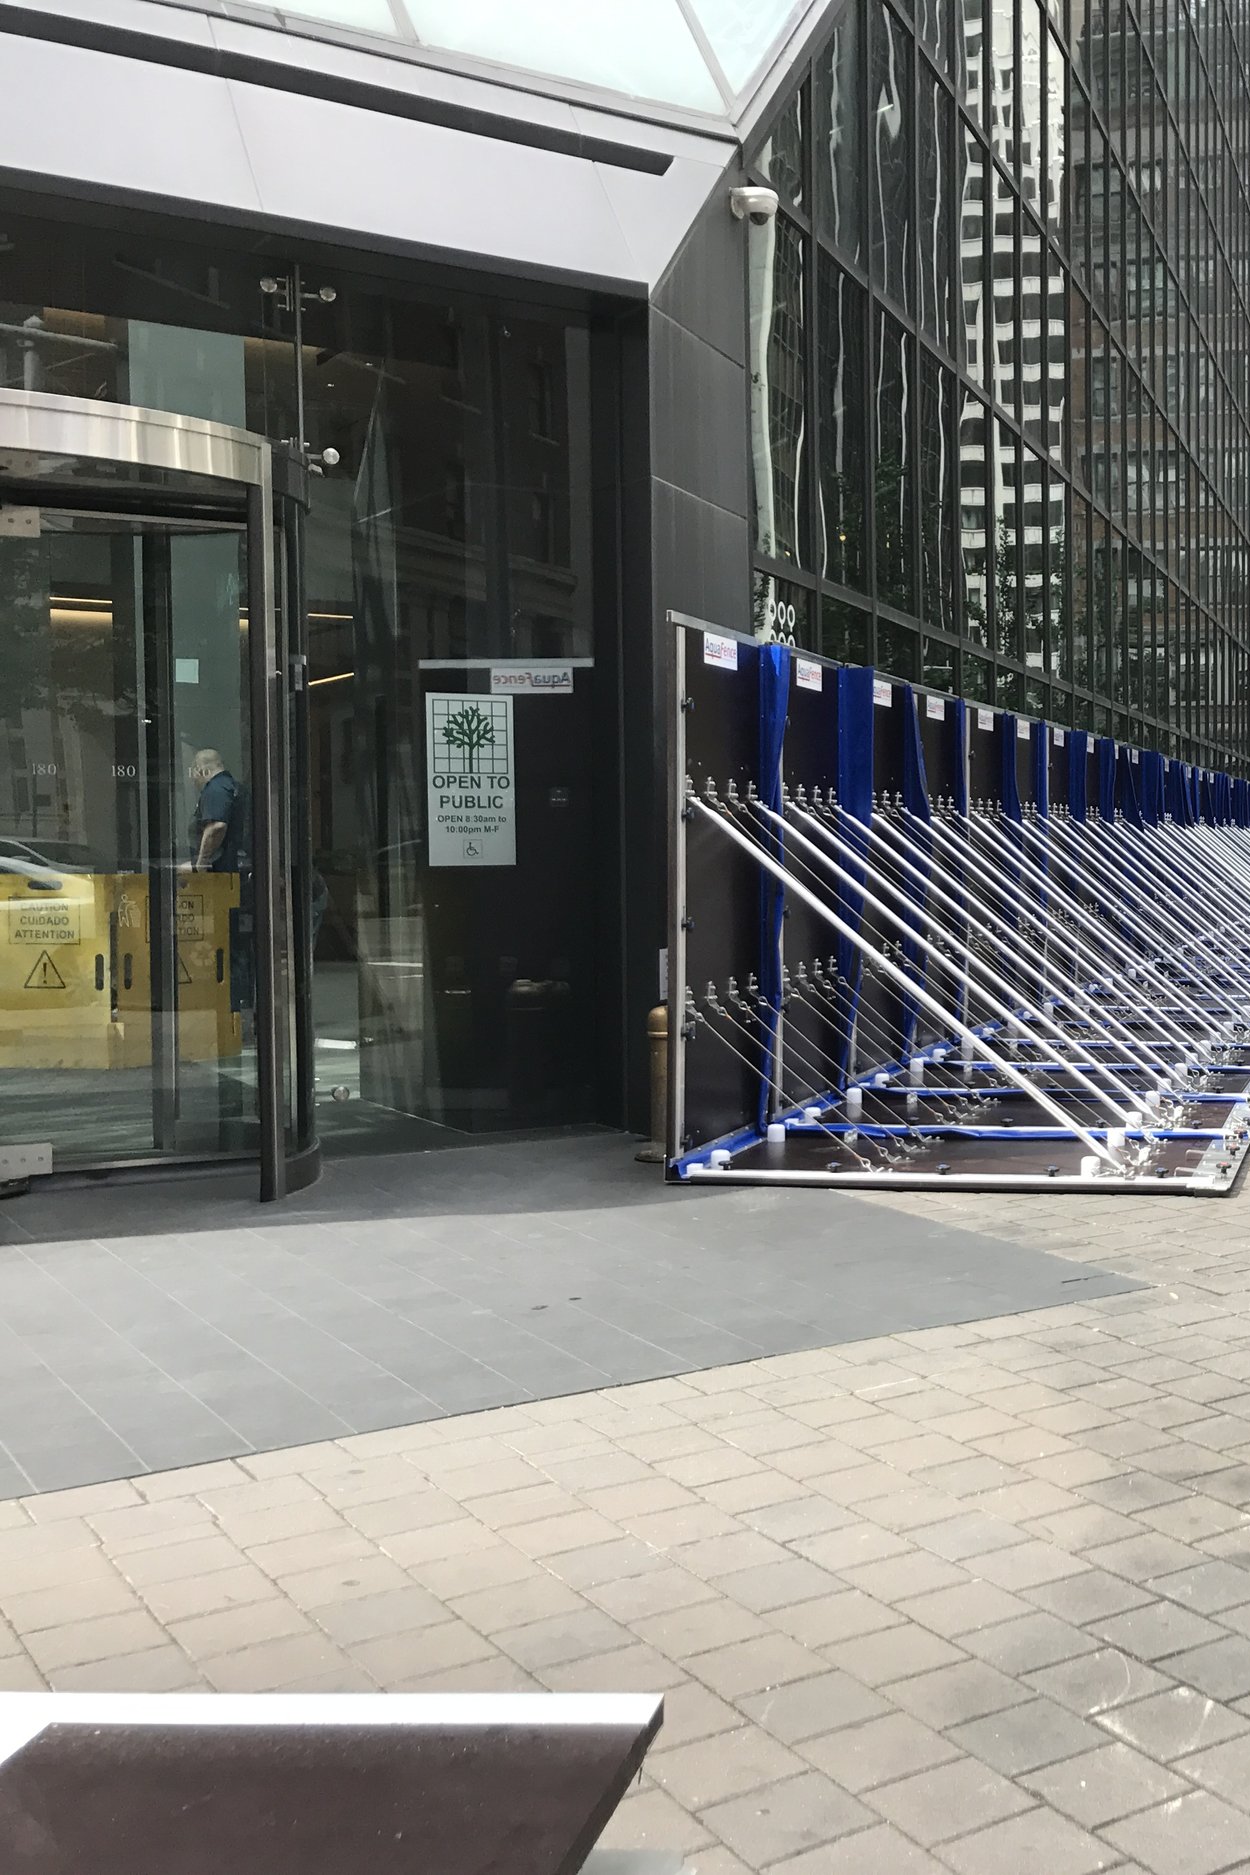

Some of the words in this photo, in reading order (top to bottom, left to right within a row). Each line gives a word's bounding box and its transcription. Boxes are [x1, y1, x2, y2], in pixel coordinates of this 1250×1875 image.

[705, 638, 737, 659] AquaFence
[32, 763, 57, 775] 180
[111, 765, 136, 777] 180
[432, 775, 481, 790] OPEN
[487, 775, 510, 789] TO
[439, 795, 504, 809] PUBLIC
[437, 815, 463, 823] OPEN
[498, 815, 507, 823] to
[445, 825, 482, 835] 10:00pm
[20, 915, 69, 926] CUIDADO
[14, 929, 75, 940] ATTENTION
